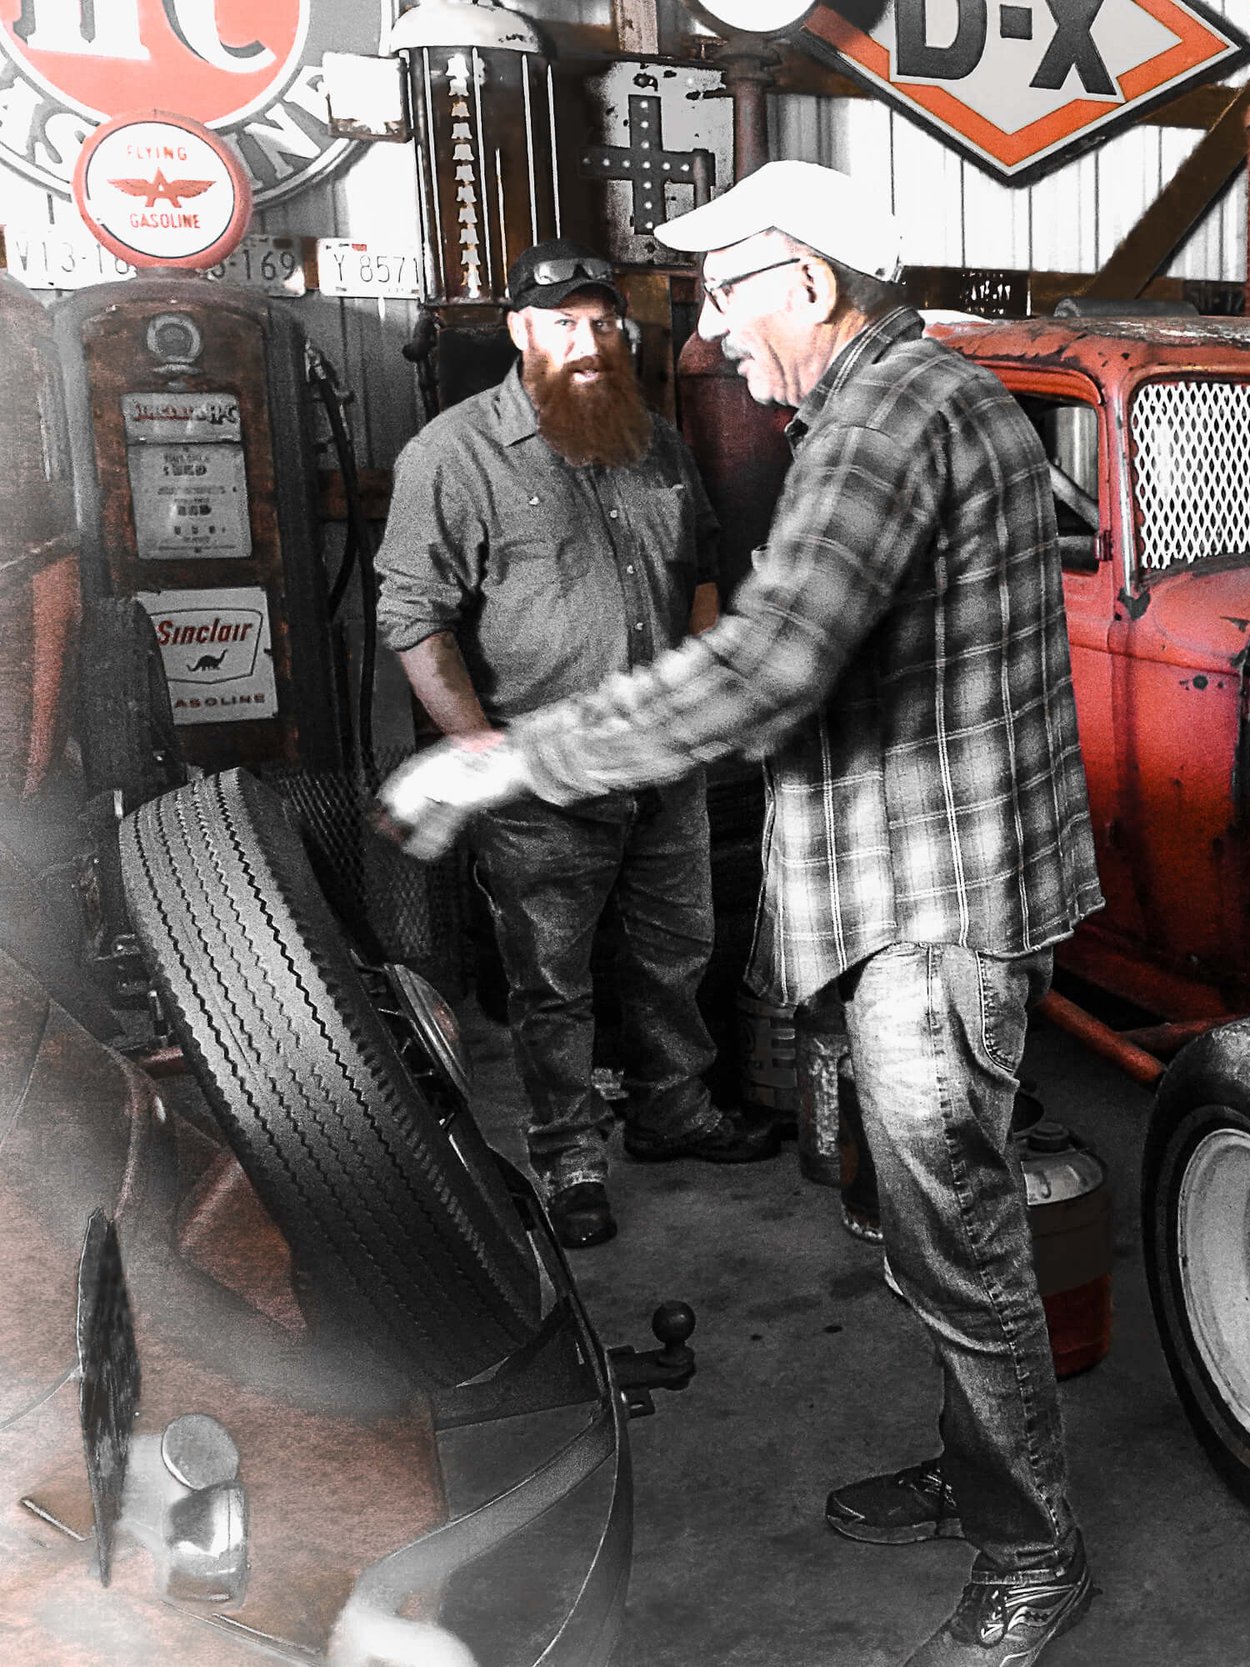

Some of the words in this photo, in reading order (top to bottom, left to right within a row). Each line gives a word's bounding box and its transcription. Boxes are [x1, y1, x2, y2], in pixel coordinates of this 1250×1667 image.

[897, 0, 1117, 95] D-X
[127, 145, 188, 161] FLYING
[129, 213, 201, 229] GASOLINE
[333, 253, 345, 282] Y
[156, 617, 253, 646] Sinclair
[174, 692, 266, 709] ASOLINE
